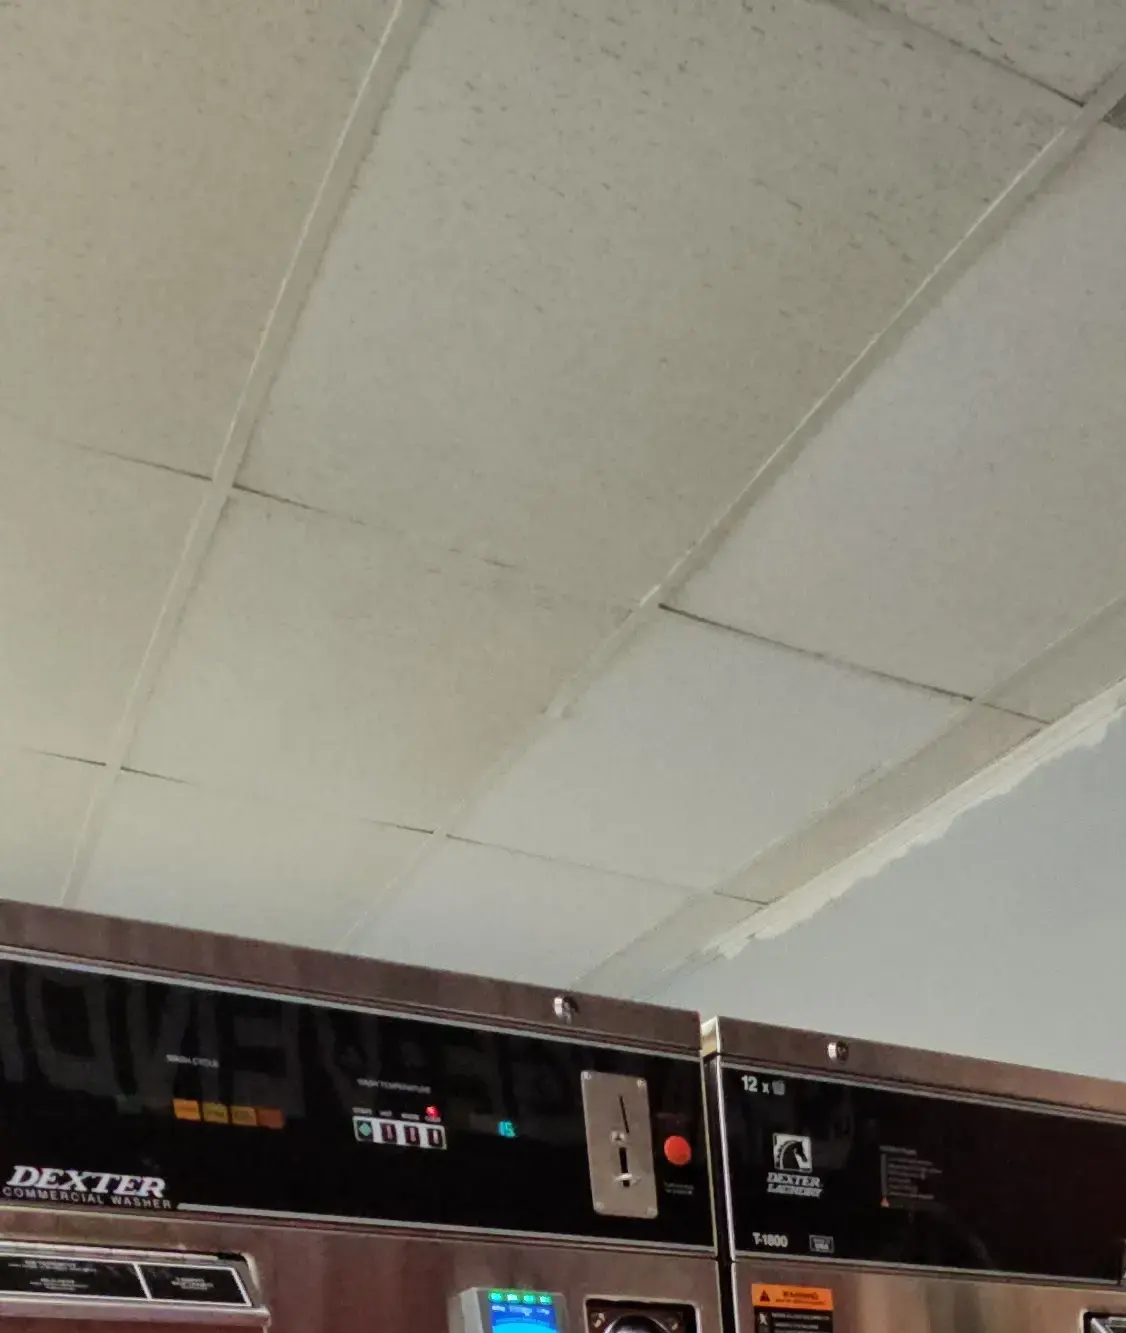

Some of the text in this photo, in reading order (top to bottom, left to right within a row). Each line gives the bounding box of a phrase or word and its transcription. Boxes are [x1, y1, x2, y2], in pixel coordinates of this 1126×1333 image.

[741, 1075, 769, 1094] 12 x
[6, 1165, 166, 1198] DEXTER
[766, 1171, 821, 1187] DEXTER
[2, 1186, 172, 1209] COMMERCIAL WASHER
